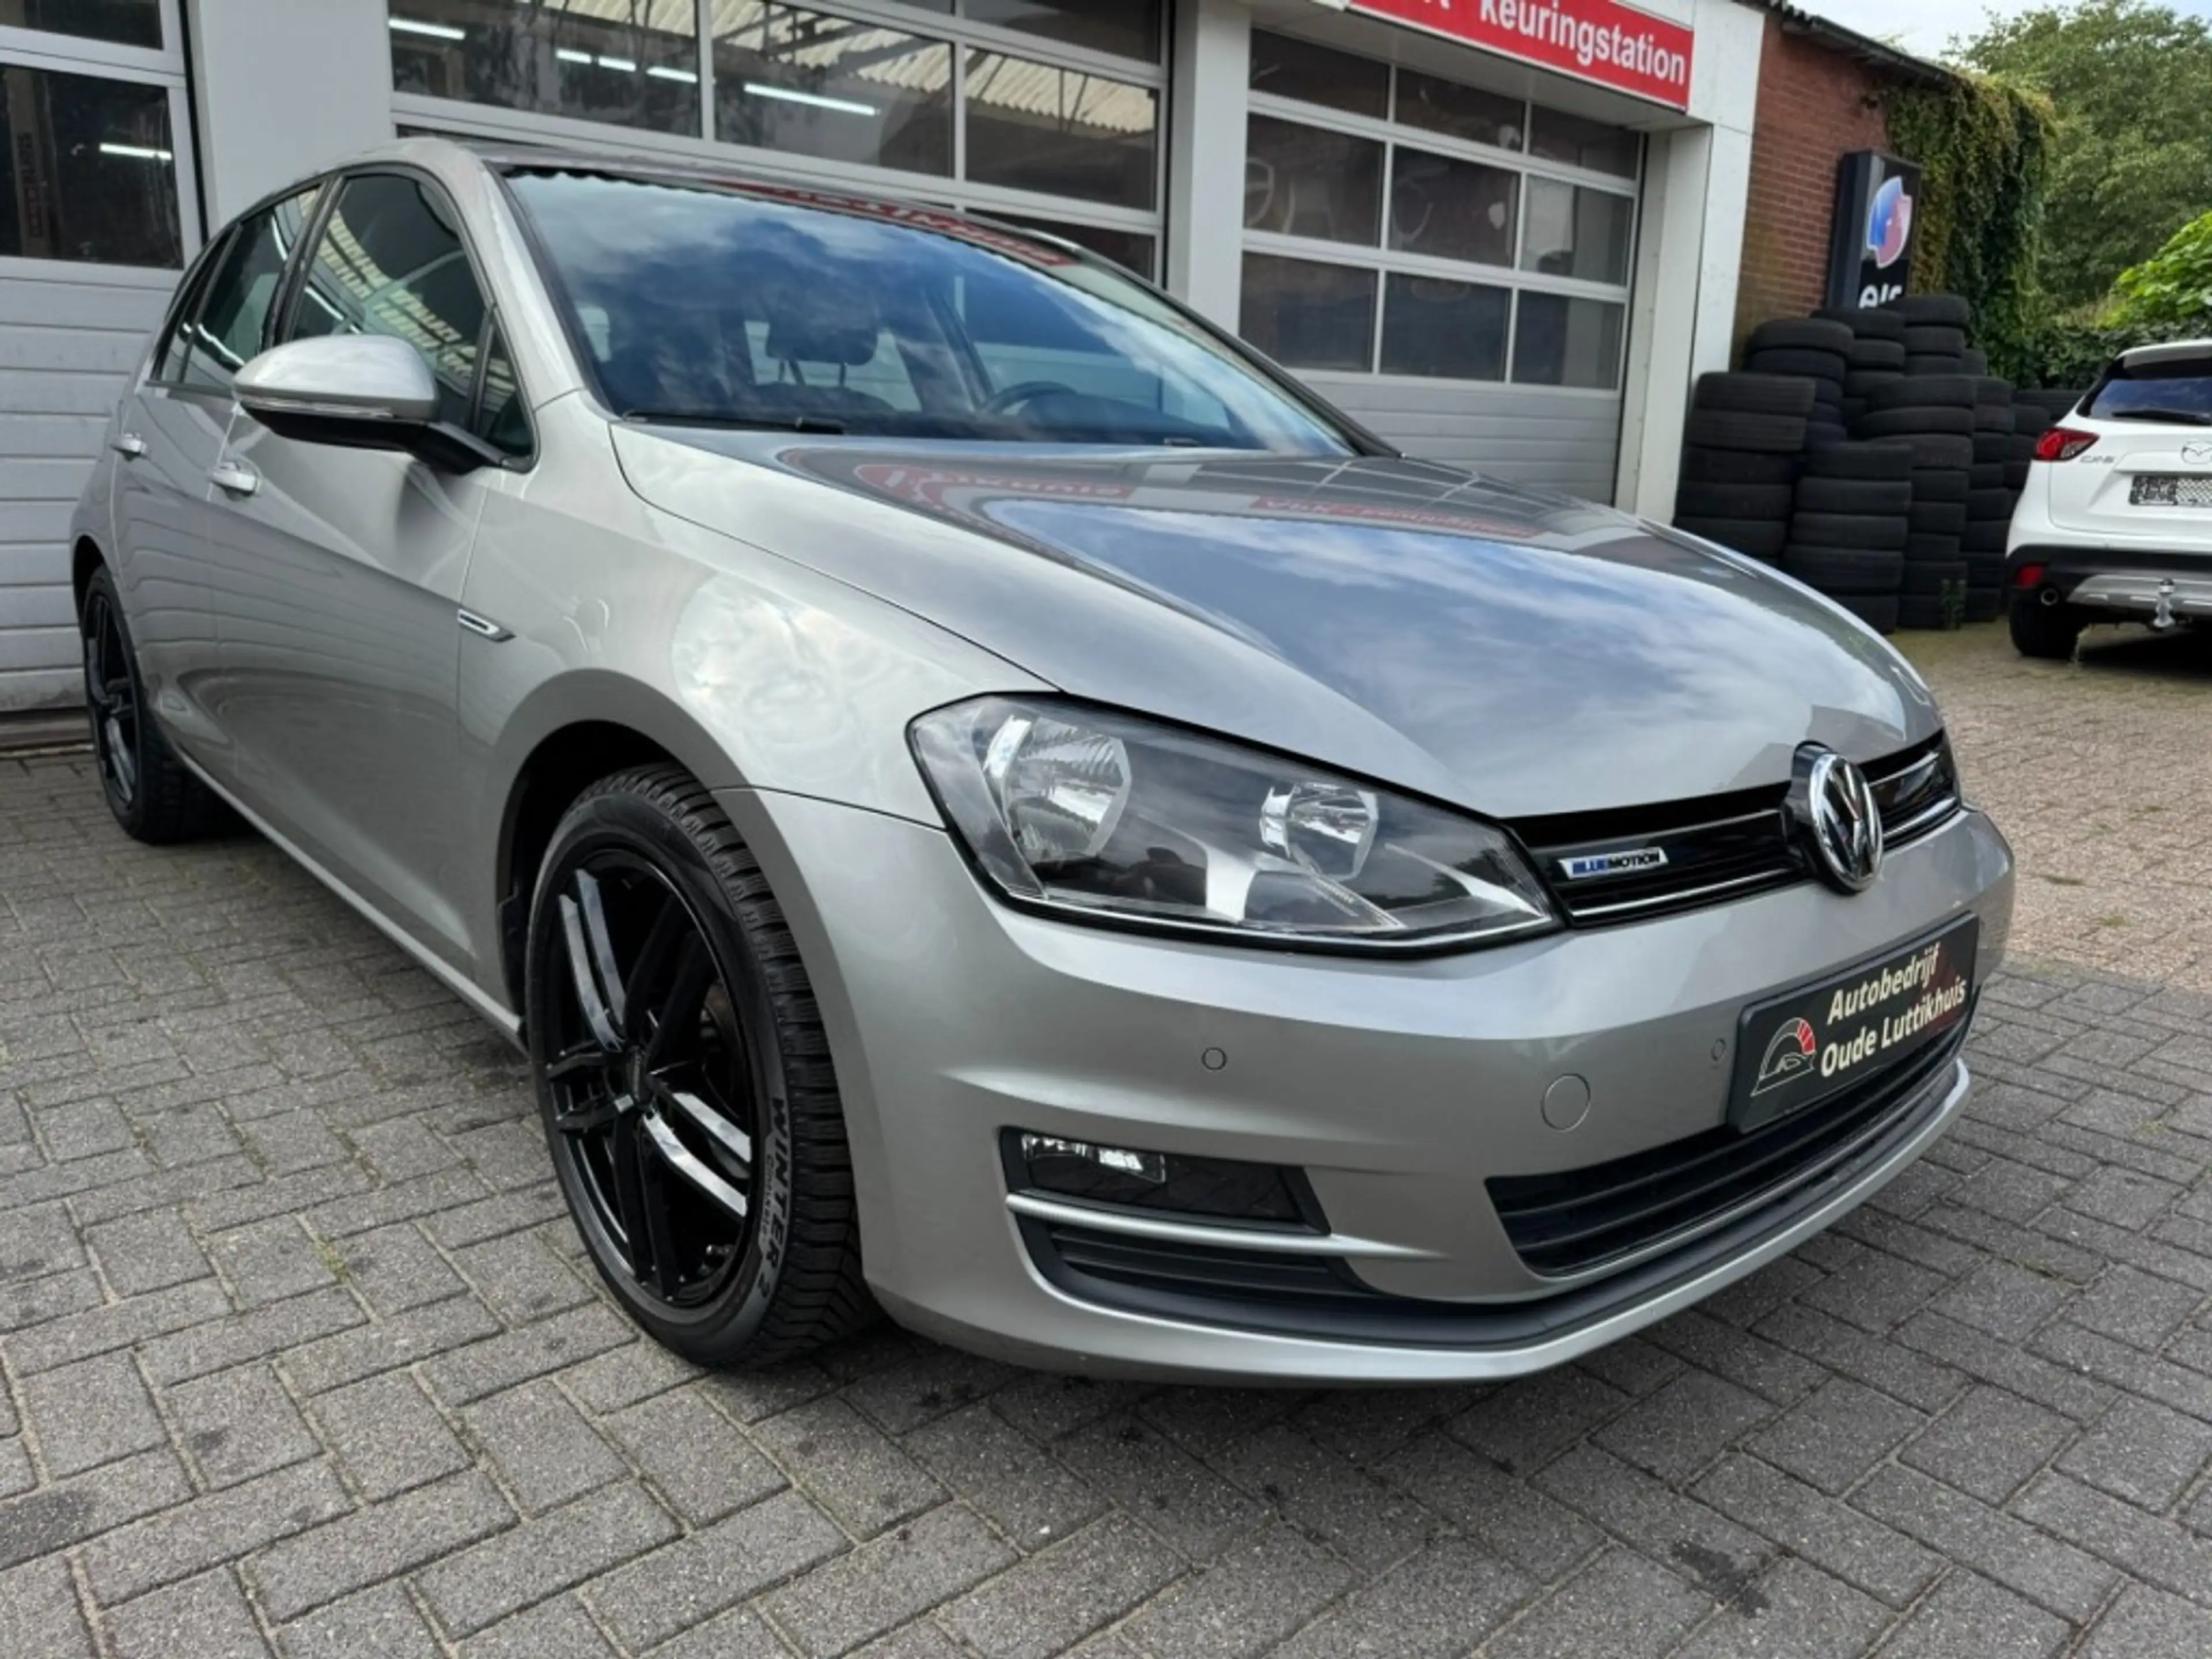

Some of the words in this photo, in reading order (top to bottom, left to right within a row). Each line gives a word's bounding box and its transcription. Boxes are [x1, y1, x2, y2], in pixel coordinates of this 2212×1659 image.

[1821, 1026, 1876, 1077] Oude
[1881, 976, 1967, 1049] Luttikhuis
[1827, 942, 1941, 1025] Autobedrijf
[767, 1097, 791, 1270] WINTER
